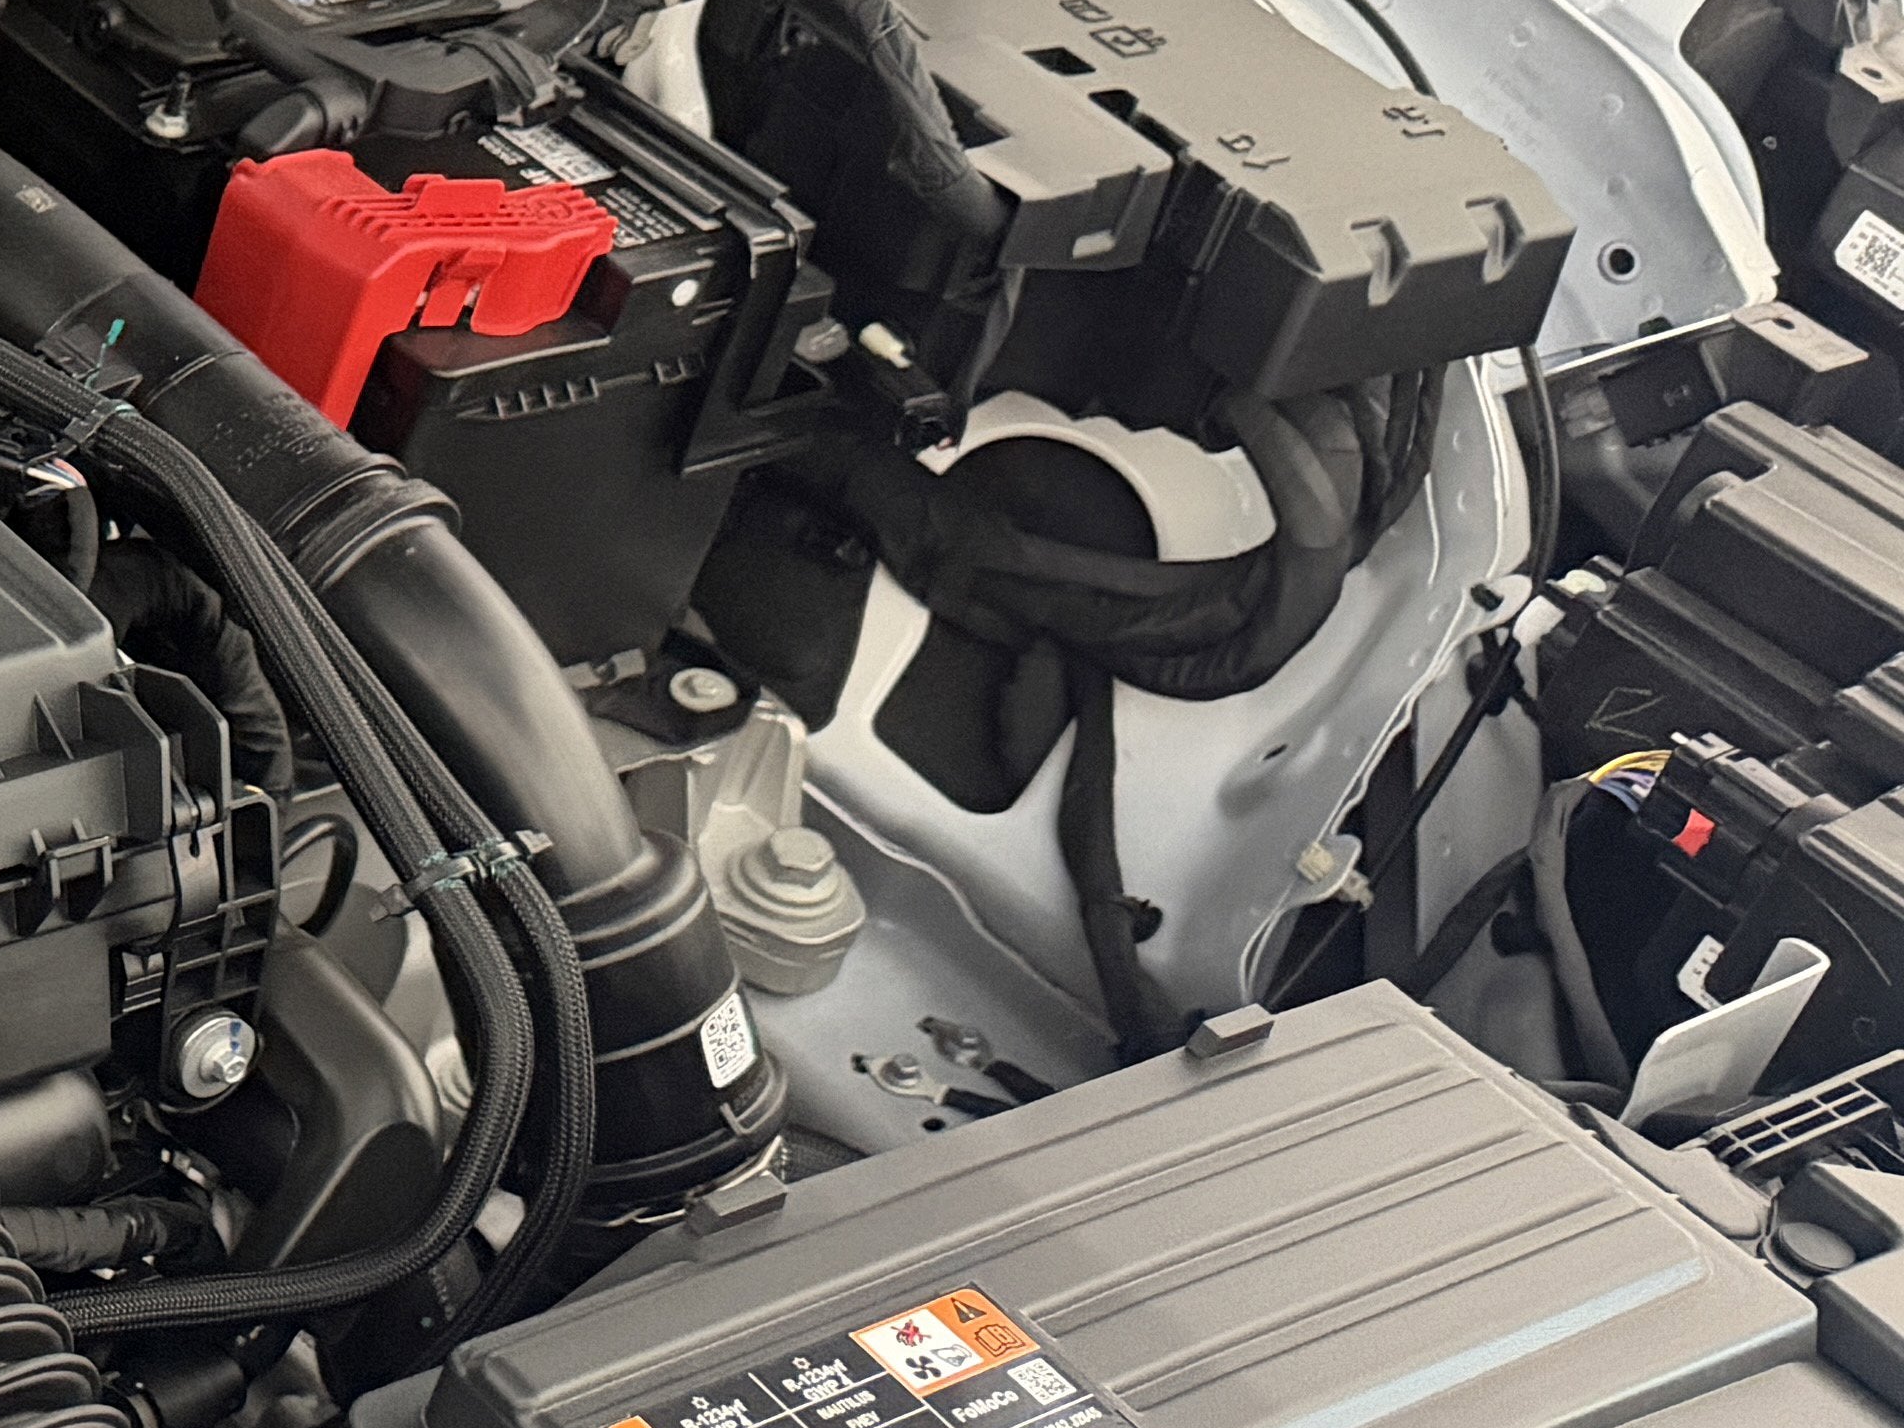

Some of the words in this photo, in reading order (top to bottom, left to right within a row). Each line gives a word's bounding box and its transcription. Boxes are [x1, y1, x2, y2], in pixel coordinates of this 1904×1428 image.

[782, 1359, 847, 1392] R-1234yf
[803, 1380, 844, 1403] GWP
[839, 1374, 855, 1387] 4
[817, 1391, 875, 1419] NAUTILUS
[952, 1391, 1019, 1422] FoMoCo
[737, 1414, 753, 1426] 4
